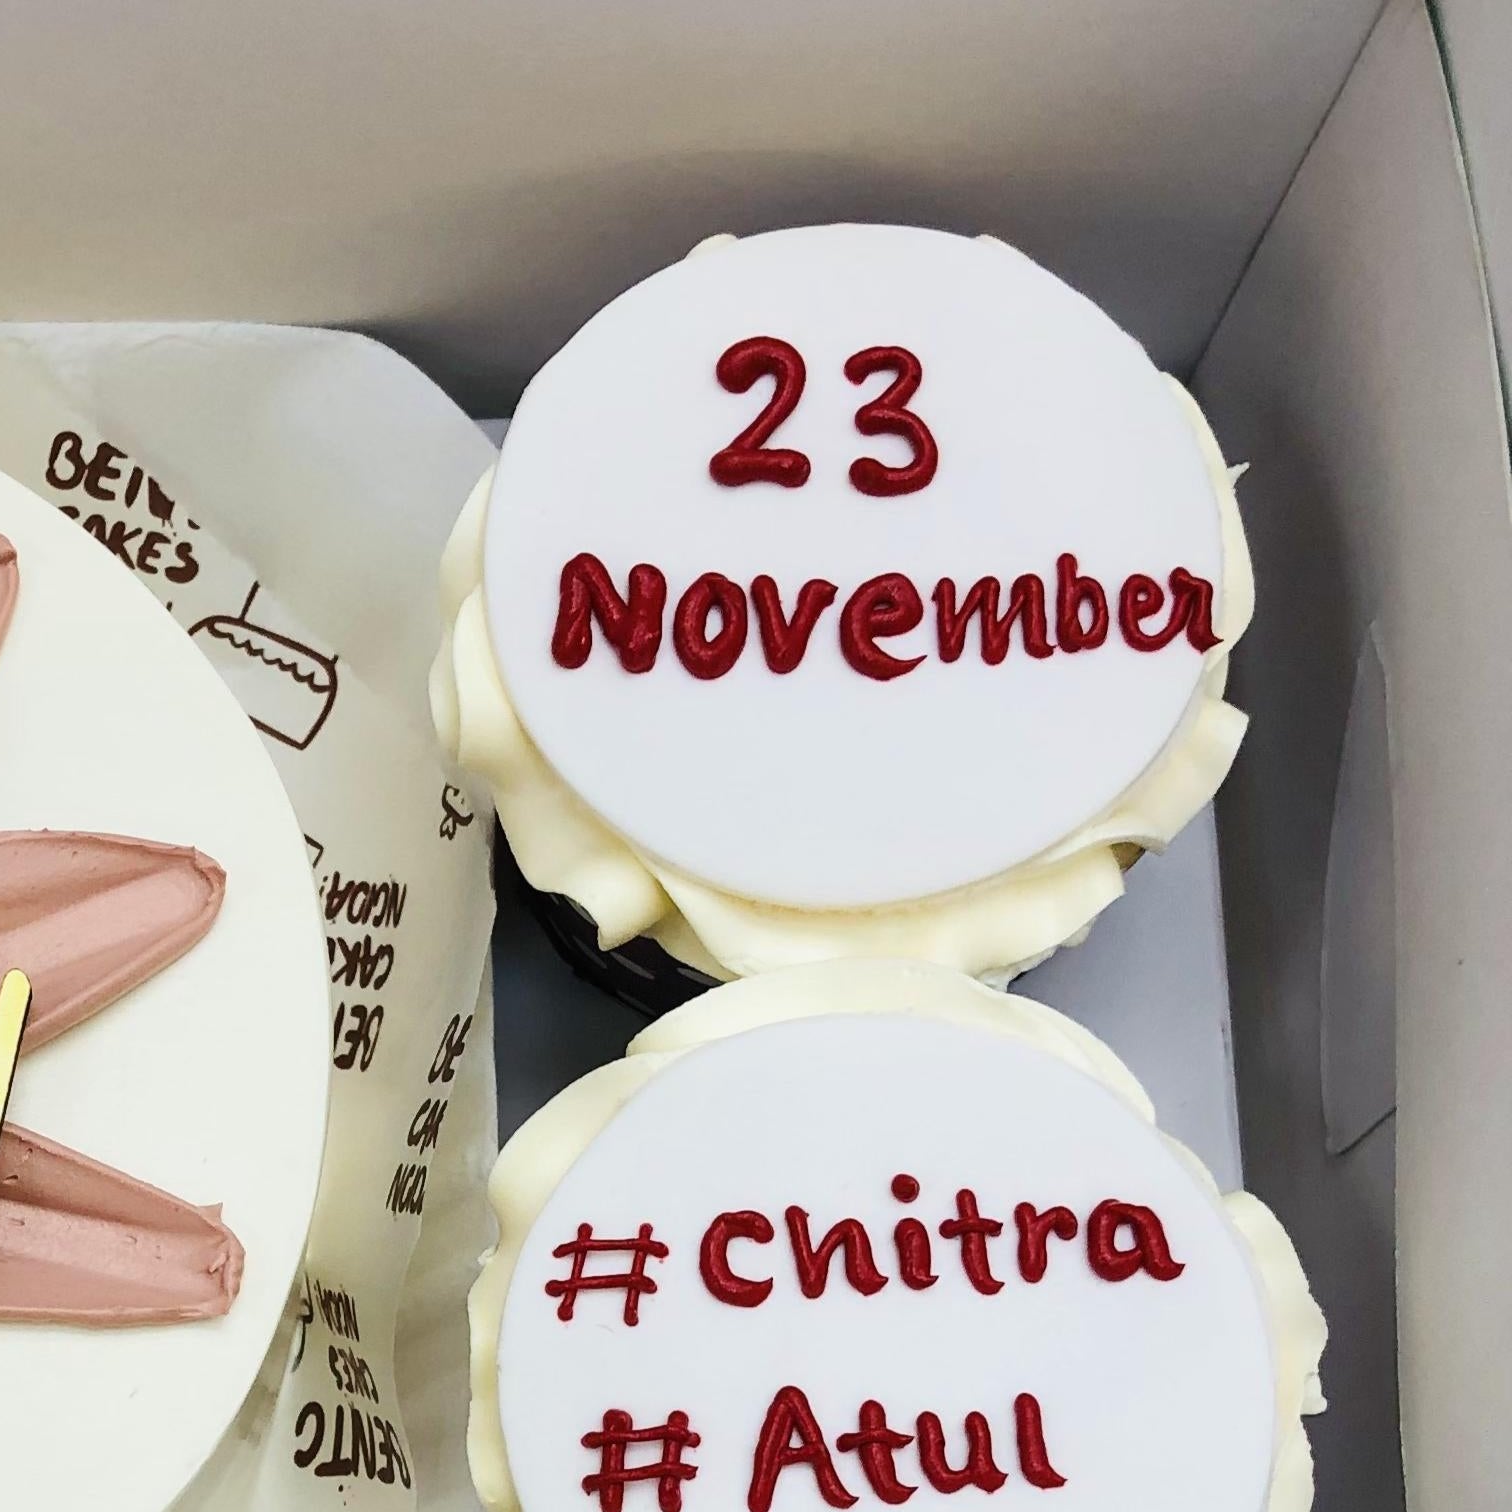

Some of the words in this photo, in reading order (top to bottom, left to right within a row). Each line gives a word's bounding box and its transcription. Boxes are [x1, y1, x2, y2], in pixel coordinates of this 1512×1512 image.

[708, 335, 940, 498] 23
[58, 505, 200, 584] AKES
[550, 551, 1226, 683] November
